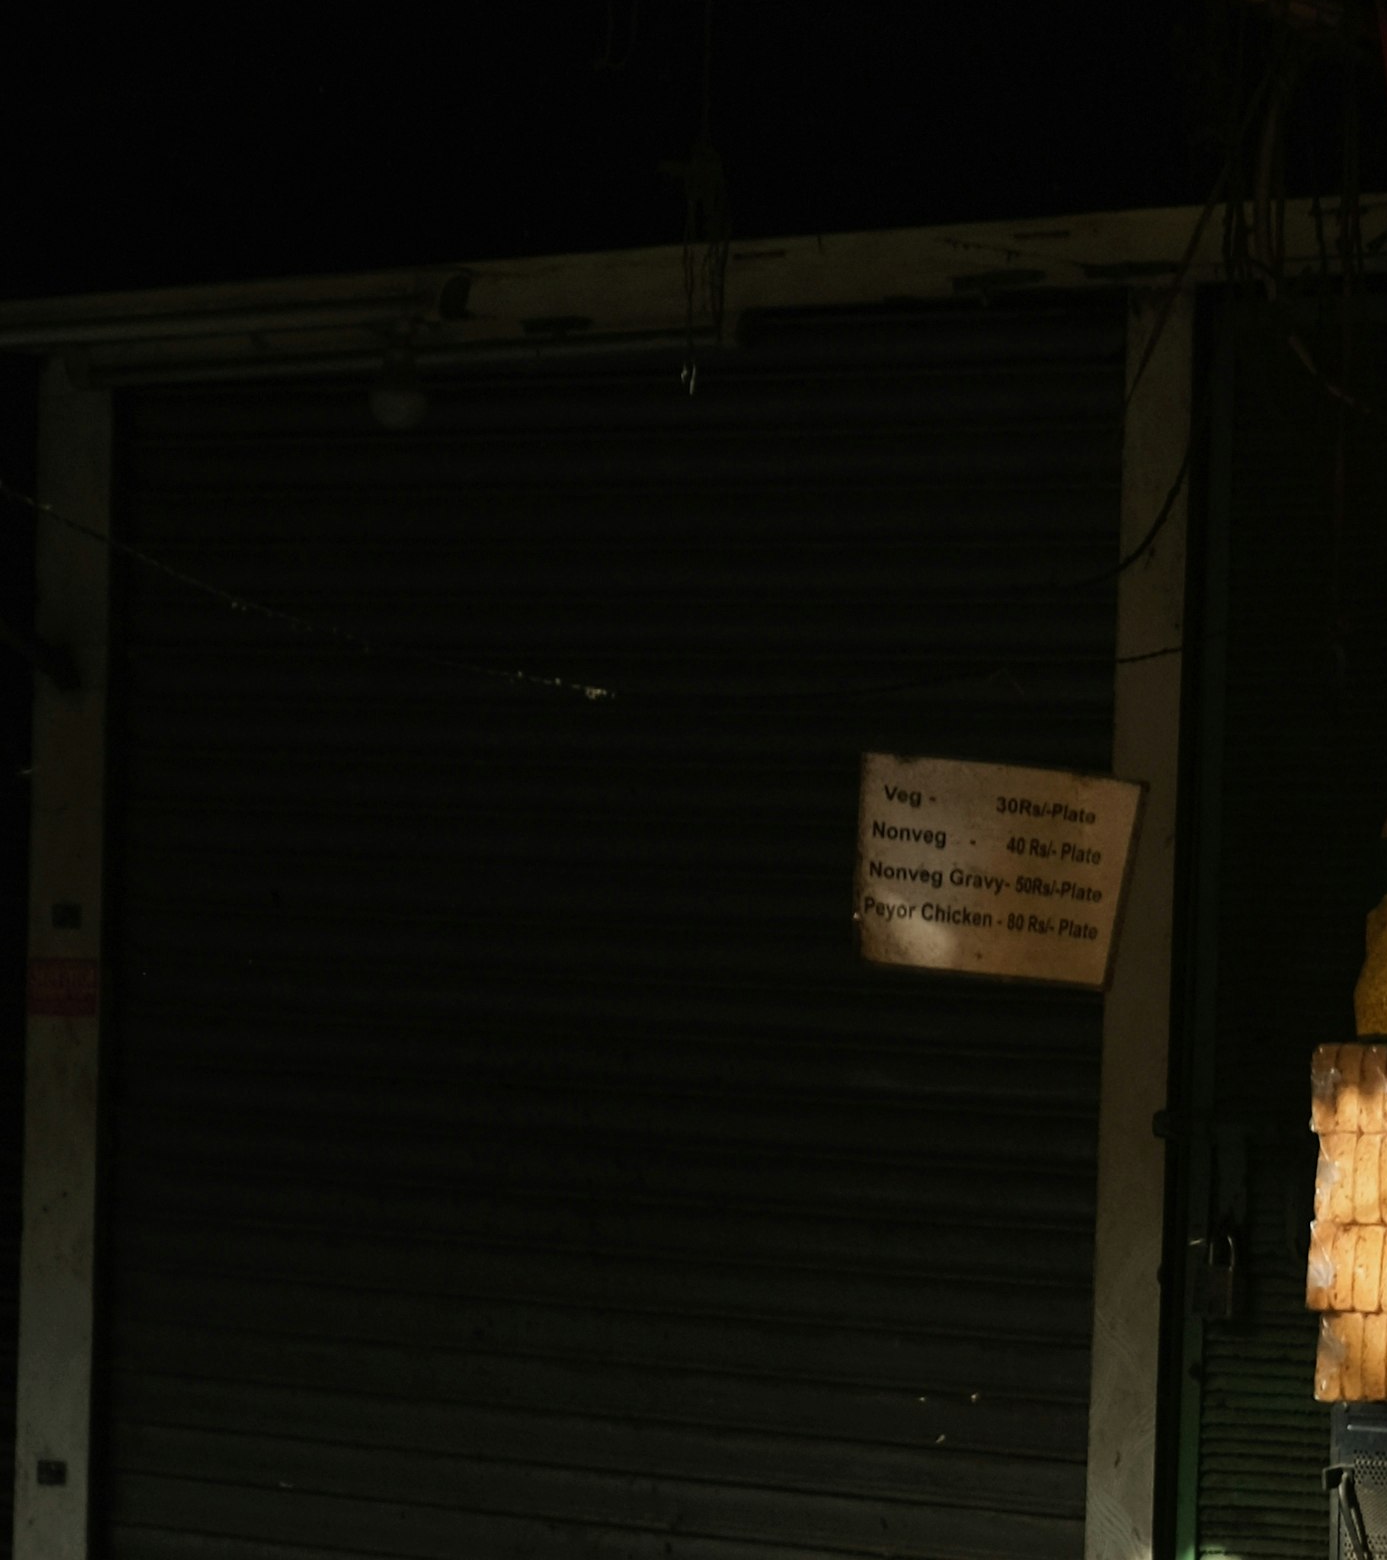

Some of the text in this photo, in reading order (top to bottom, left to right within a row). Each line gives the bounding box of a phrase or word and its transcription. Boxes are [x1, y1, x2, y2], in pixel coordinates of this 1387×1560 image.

[885, 785, 922, 808] Veg
[872, 821, 947, 848] Nonveg
[1006, 837, 1025, 855] 40
[1061, 842, 1101, 865] Plate
[869, 861, 943, 888] Nonveg
[921, 903, 992, 928] Chicken
[1058, 918, 1098, 940] Plate
